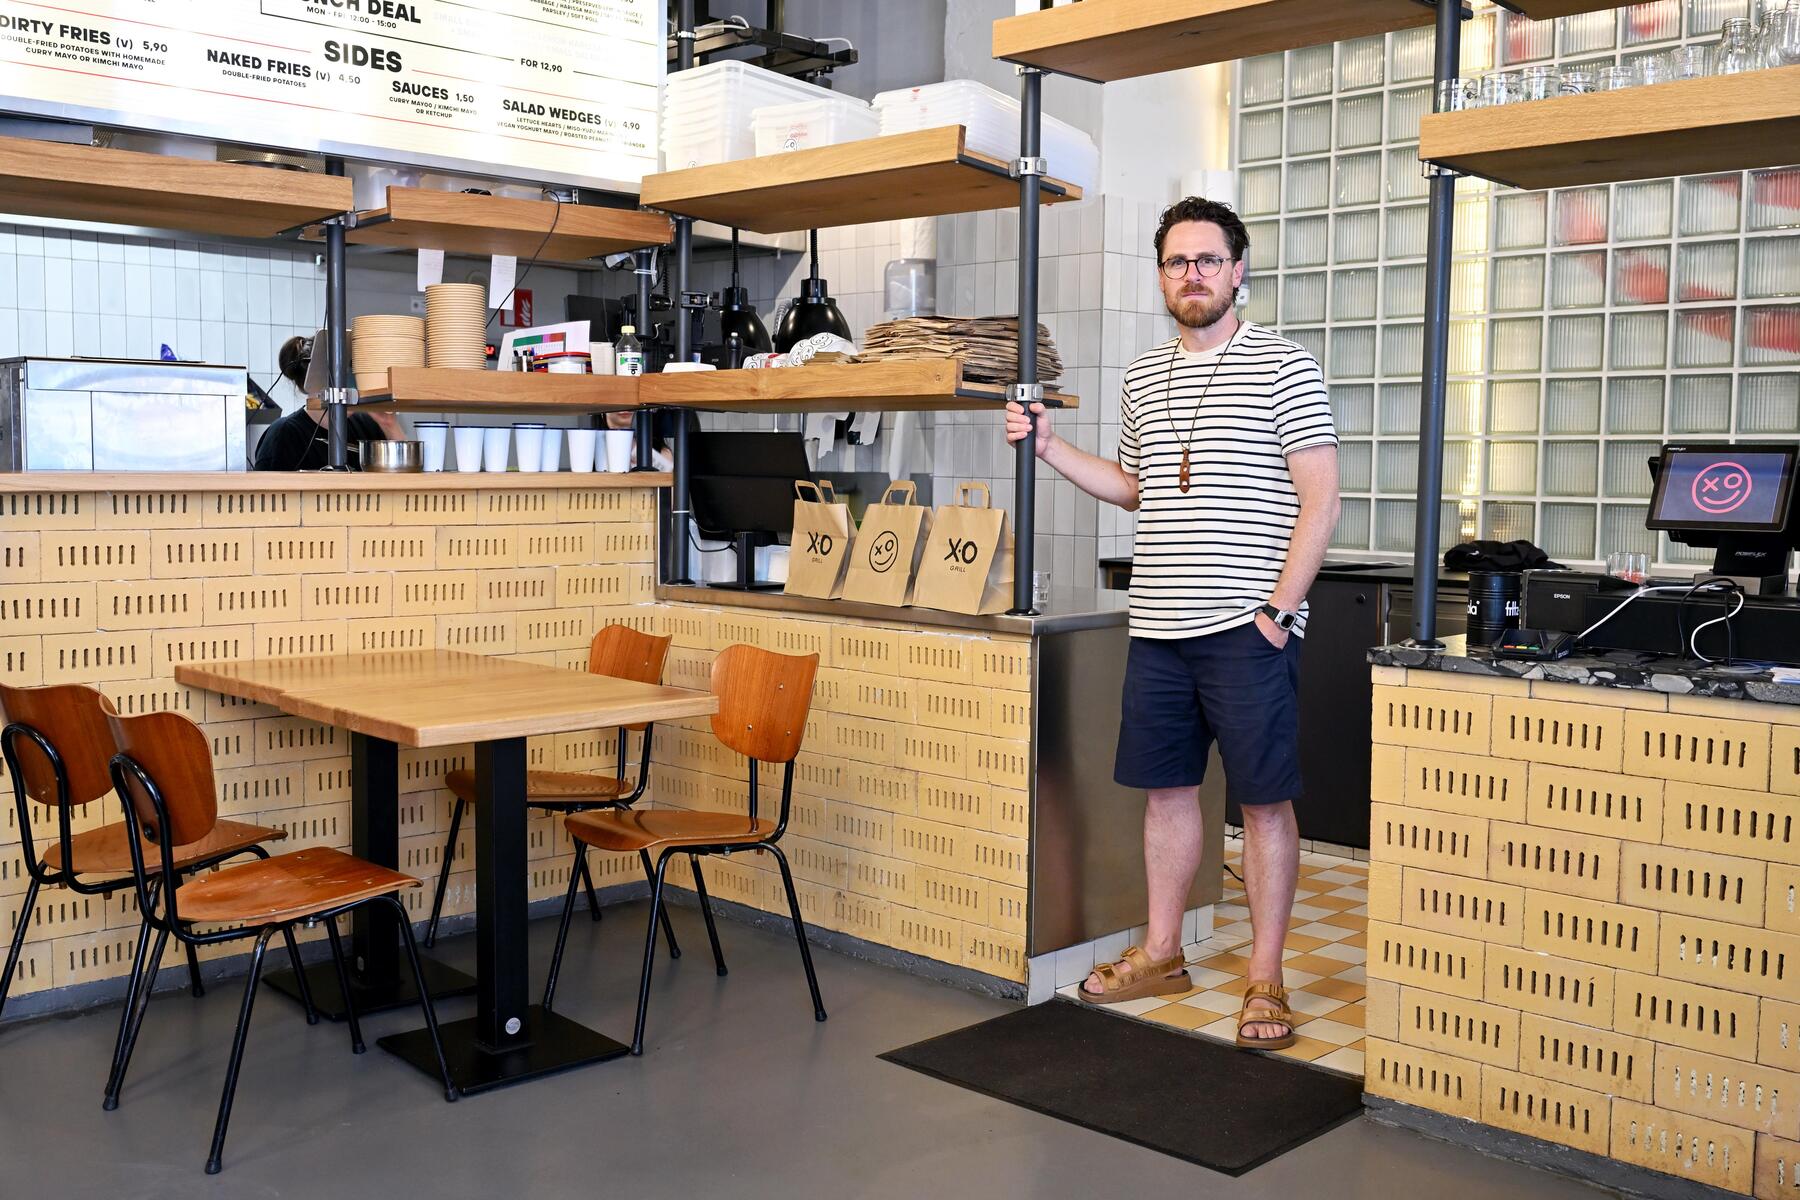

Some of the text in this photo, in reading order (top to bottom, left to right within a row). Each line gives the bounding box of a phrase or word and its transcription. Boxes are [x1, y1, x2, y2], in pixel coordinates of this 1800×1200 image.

[306, 6, 325, 15] MON
[350, 15, 369, 24] 12:00
[377, 19, 397, 29] 15:00
[368, 0, 421, 24] DEAL
[542, 6, 566, 16] PARSLEY
[0, 15, 168, 53] DIRTY FRIES (V) 5,90
[1, 34, 166, 66] DOUBLE-FRIED POTATOES WITH HOMEMADE
[25, 47, 144, 71] CURRY MAYO OR KIMCHI MAYO
[324, 40, 402, 73] SIDES
[207, 48, 262, 70] NAKED
[267, 59, 311, 78] FRIES
[315, 70, 331, 82] (V)
[520, 58, 538, 69] FOR
[222, 69, 307, 88] DOUBLE-FRIED POTATOES
[392, 80, 475, 103] SAUCES 1,50
[389, 96, 410, 104] CURRY
[438, 104, 460, 112] KIMCHI
[460, 108, 477, 116] MAYO
[425, 110, 453, 118] KETCHUP
[502, 99, 545, 116] SALAD
[549, 106, 601, 125] WEDGES
[496, 121, 516, 129] VEGAN
[516, 124, 542, 133] YOGHURT
[543, 127, 559, 136] MAYO
[563, 131, 588, 140] ROASTED
[516, 117, 540, 126] LETTUCE
[541, 121, 562, 129] HEARTS
